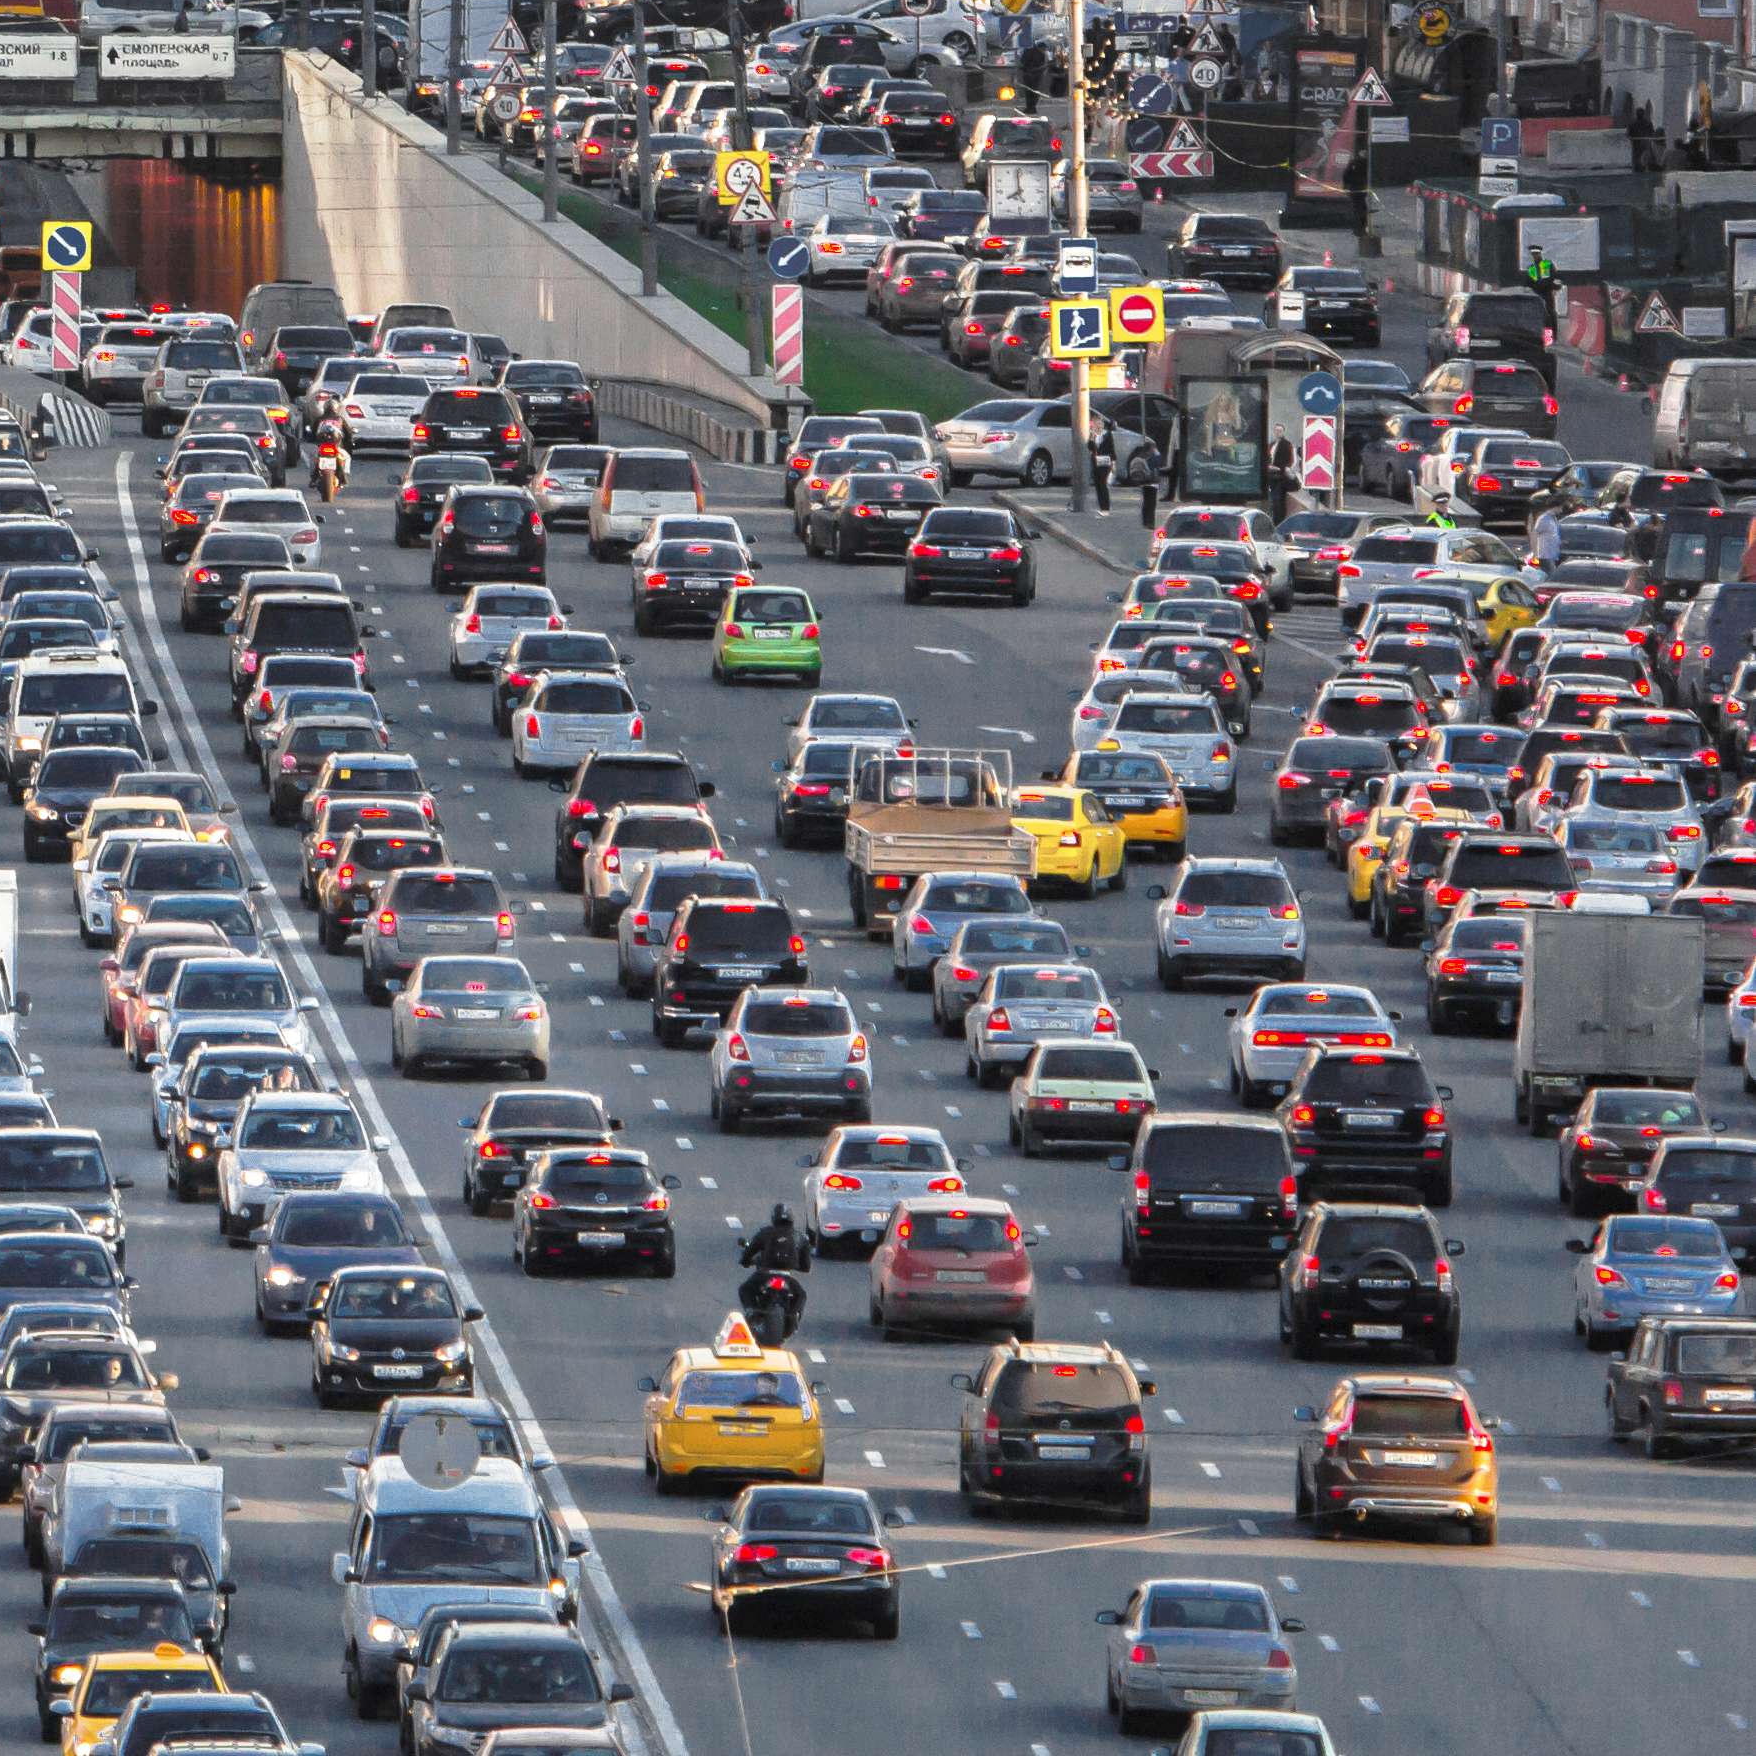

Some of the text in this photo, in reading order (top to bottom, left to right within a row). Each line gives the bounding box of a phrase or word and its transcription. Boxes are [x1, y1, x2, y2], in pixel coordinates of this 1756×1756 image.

[122, 43, 211, 55] СМОЛЕНСКАЯ
[122, 58, 180, 69] площадь
[1195, 68, 1216, 82] 40
